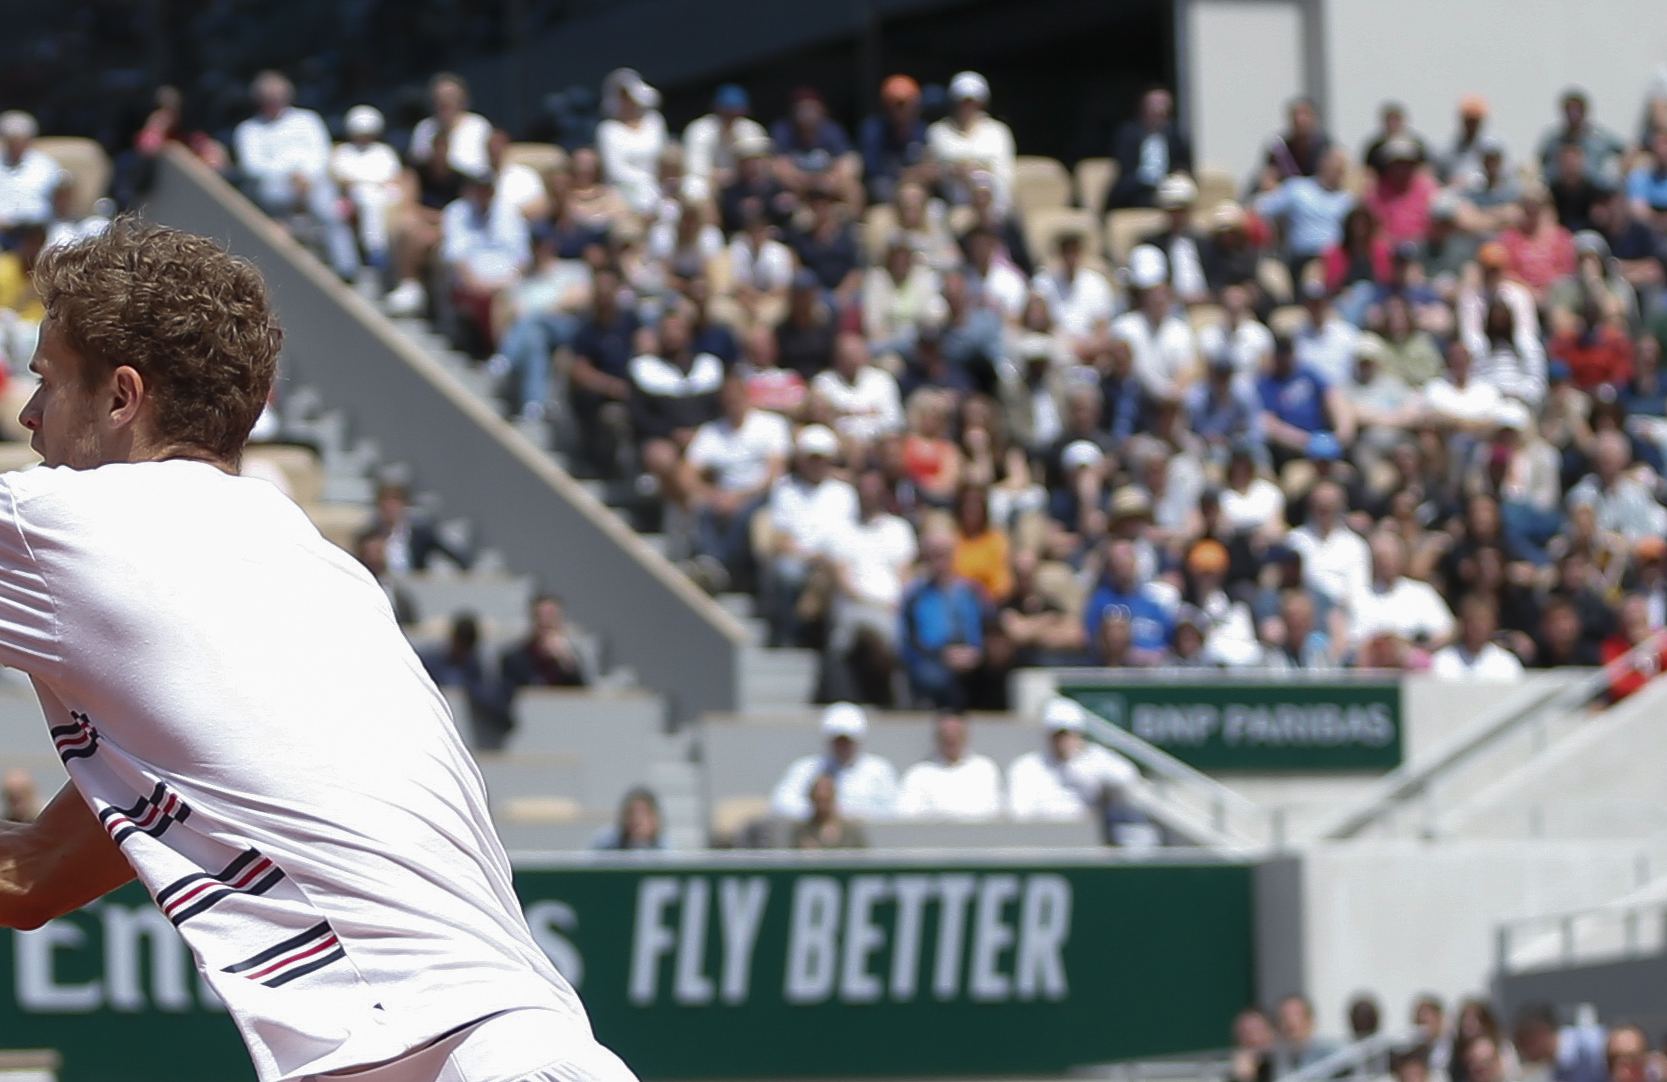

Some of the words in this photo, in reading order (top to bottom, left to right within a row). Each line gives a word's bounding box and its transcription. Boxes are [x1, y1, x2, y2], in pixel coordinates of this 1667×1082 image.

[1134, 702, 1217, 746] BNP
[1221, 702, 1394, 747] PARIBAS
[628, 875, 771, 1004] FLY
[782, 872, 1074, 1004] BETTER
